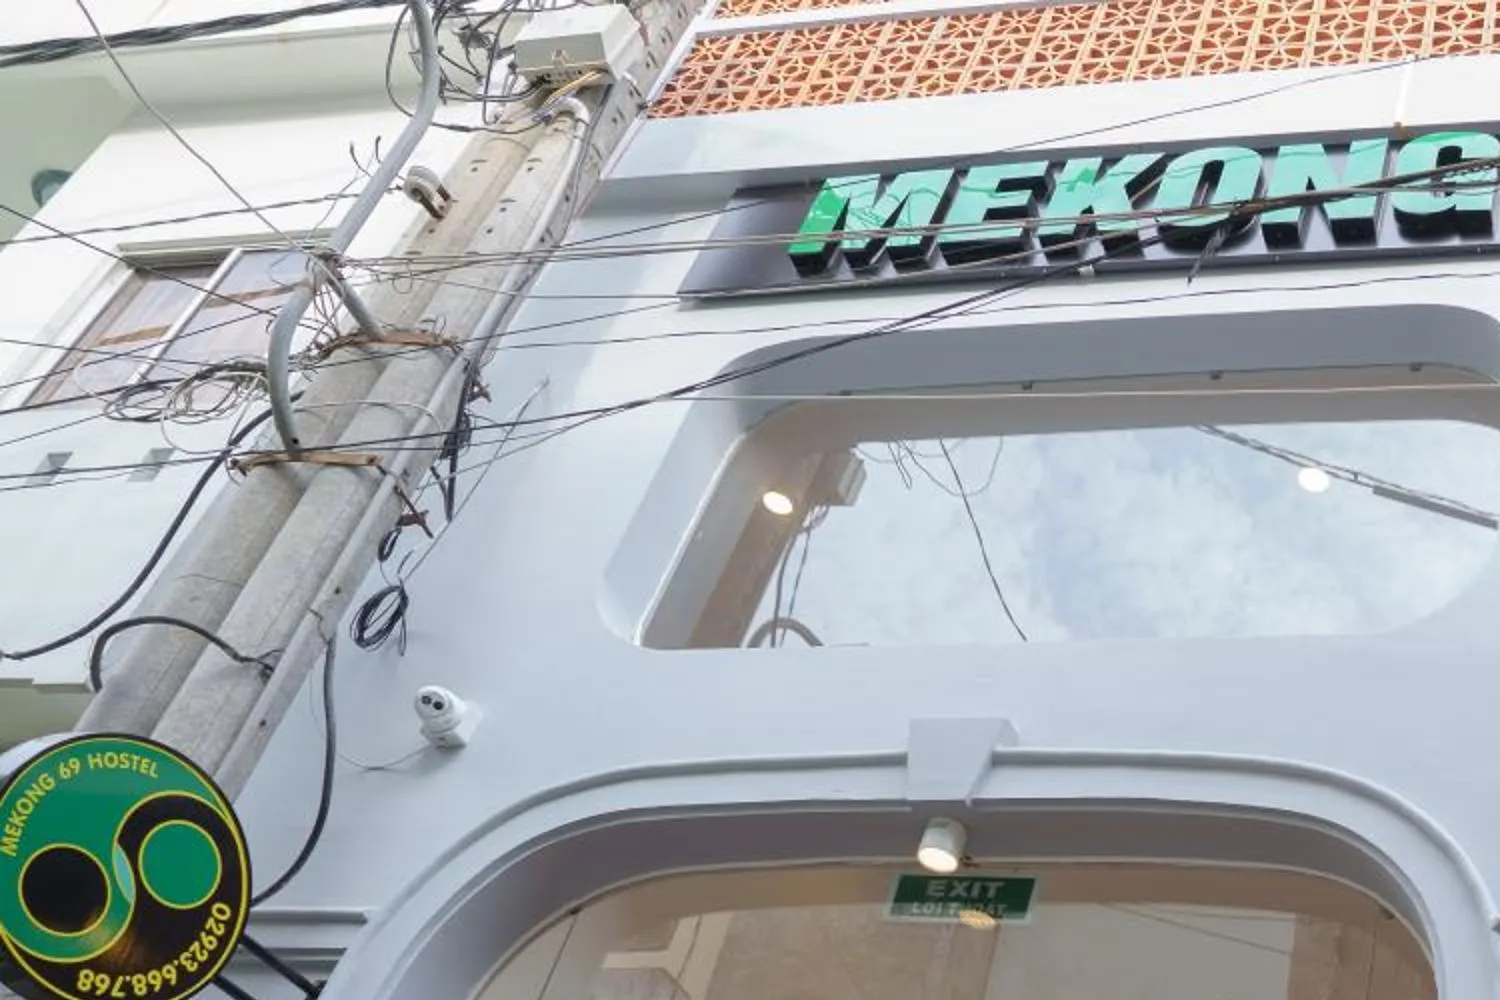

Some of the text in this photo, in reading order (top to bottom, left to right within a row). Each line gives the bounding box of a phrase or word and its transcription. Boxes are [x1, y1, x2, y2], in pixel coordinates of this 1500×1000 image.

[0, 752, 159, 857] MEKONG 69 HOSTEL
[927, 879, 1004, 898] EXIT
[76, 903, 232, 998] 02923.668.768
